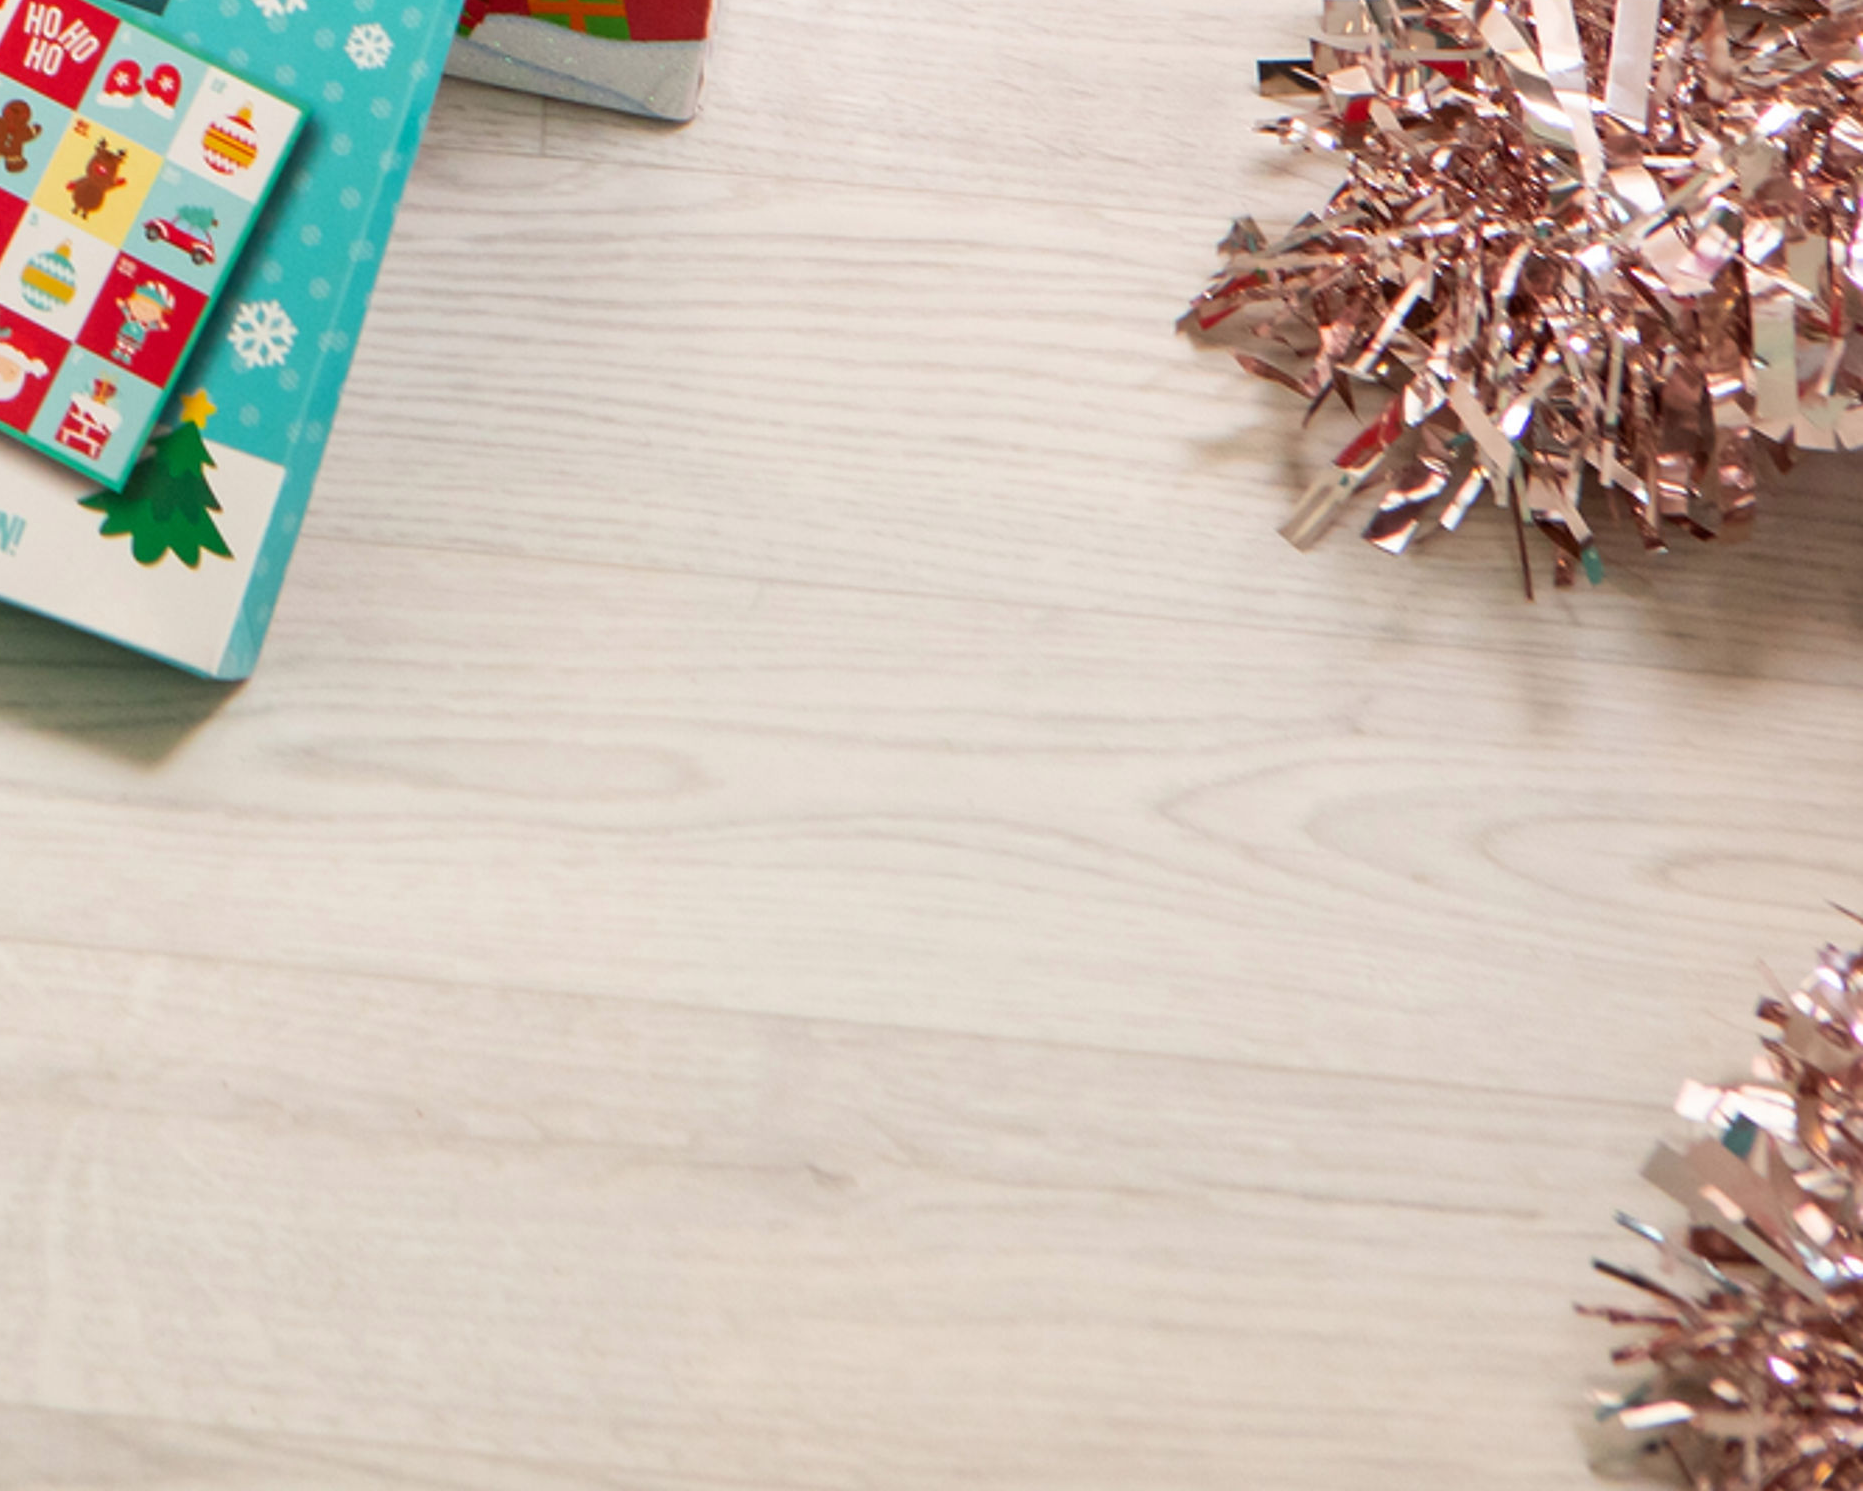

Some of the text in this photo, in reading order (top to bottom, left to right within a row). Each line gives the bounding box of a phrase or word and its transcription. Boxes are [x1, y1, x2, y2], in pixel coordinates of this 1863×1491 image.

[23, 0, 101, 64] HO HO
[23, 36, 65, 77] HO
